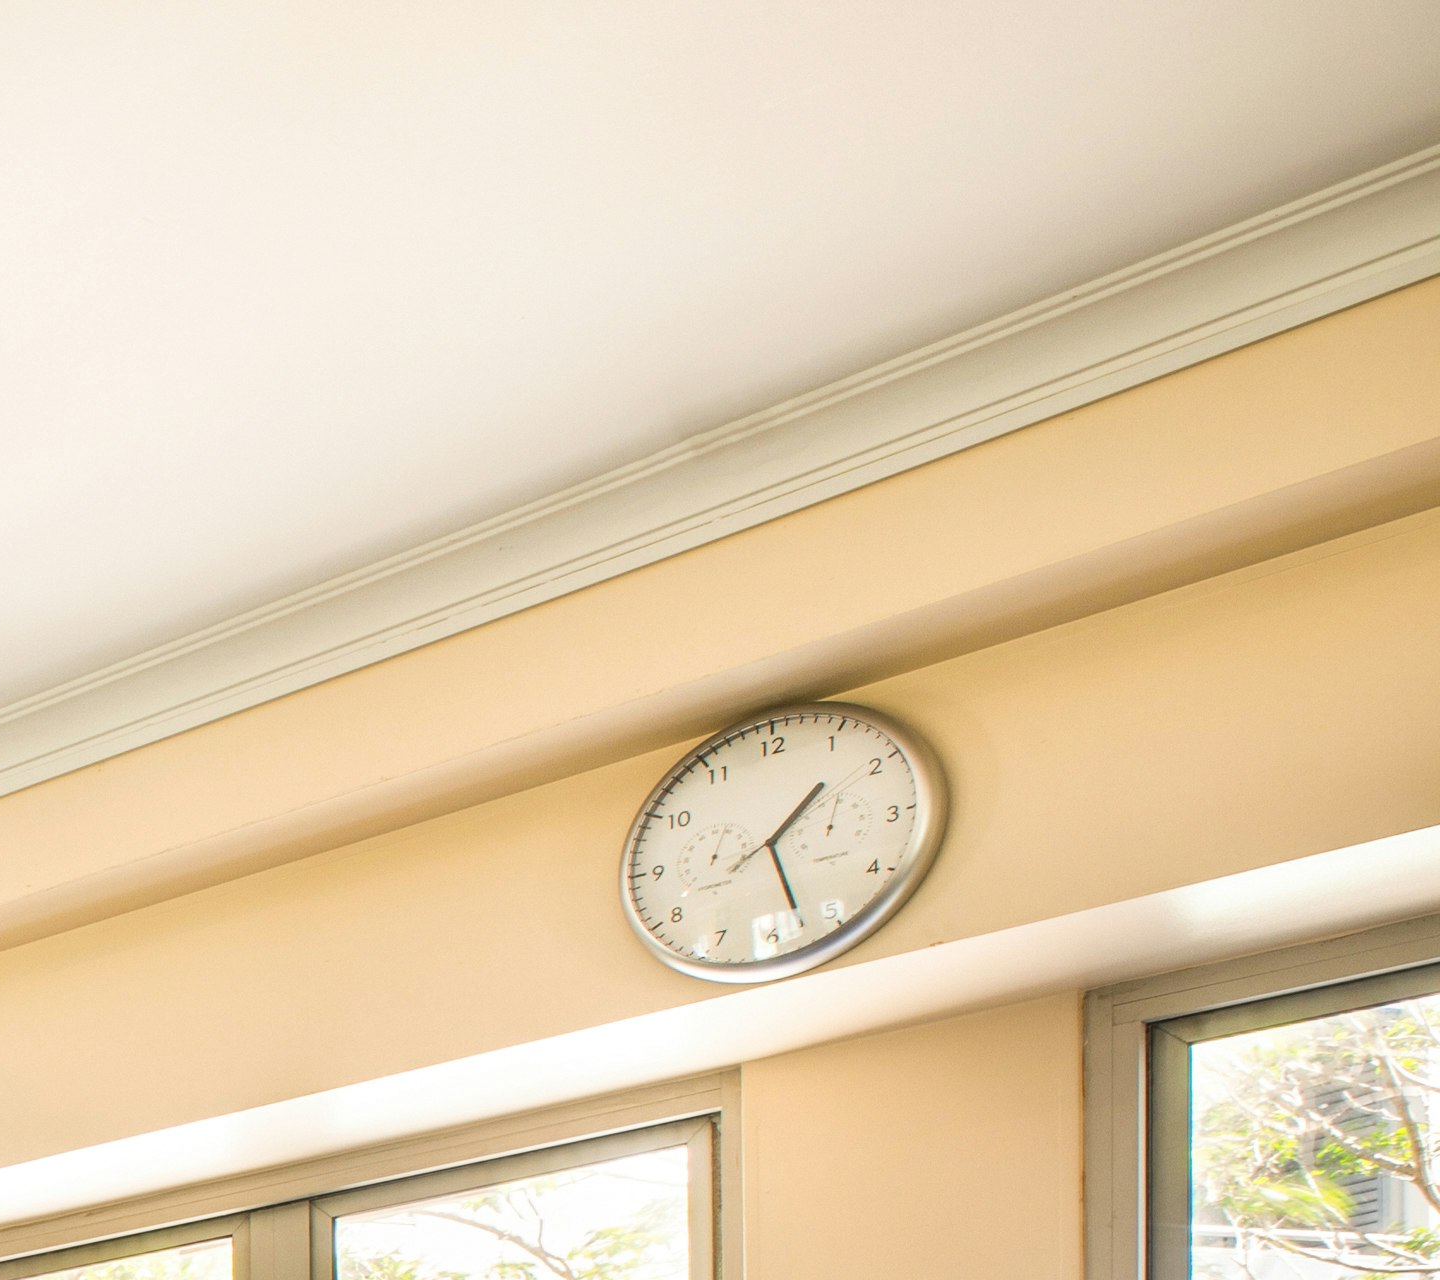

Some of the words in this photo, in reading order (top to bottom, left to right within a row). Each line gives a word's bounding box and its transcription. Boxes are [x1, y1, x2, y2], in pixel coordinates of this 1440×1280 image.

[760, 736, 786, 758] 12
[828, 736, 835, 752] 1
[707, 765, 729, 785] 11
[868, 757, 883, 776] 2
[668, 811, 691, 830] 10
[886, 805, 900, 823] 3
[651, 864, 666, 881] 9
[866, 858, 881, 876] 4
[670, 906, 683, 923] 8
[824, 903, 838, 920] 5
[714, 929, 727, 946] 7
[767, 927, 780, 945] 6
